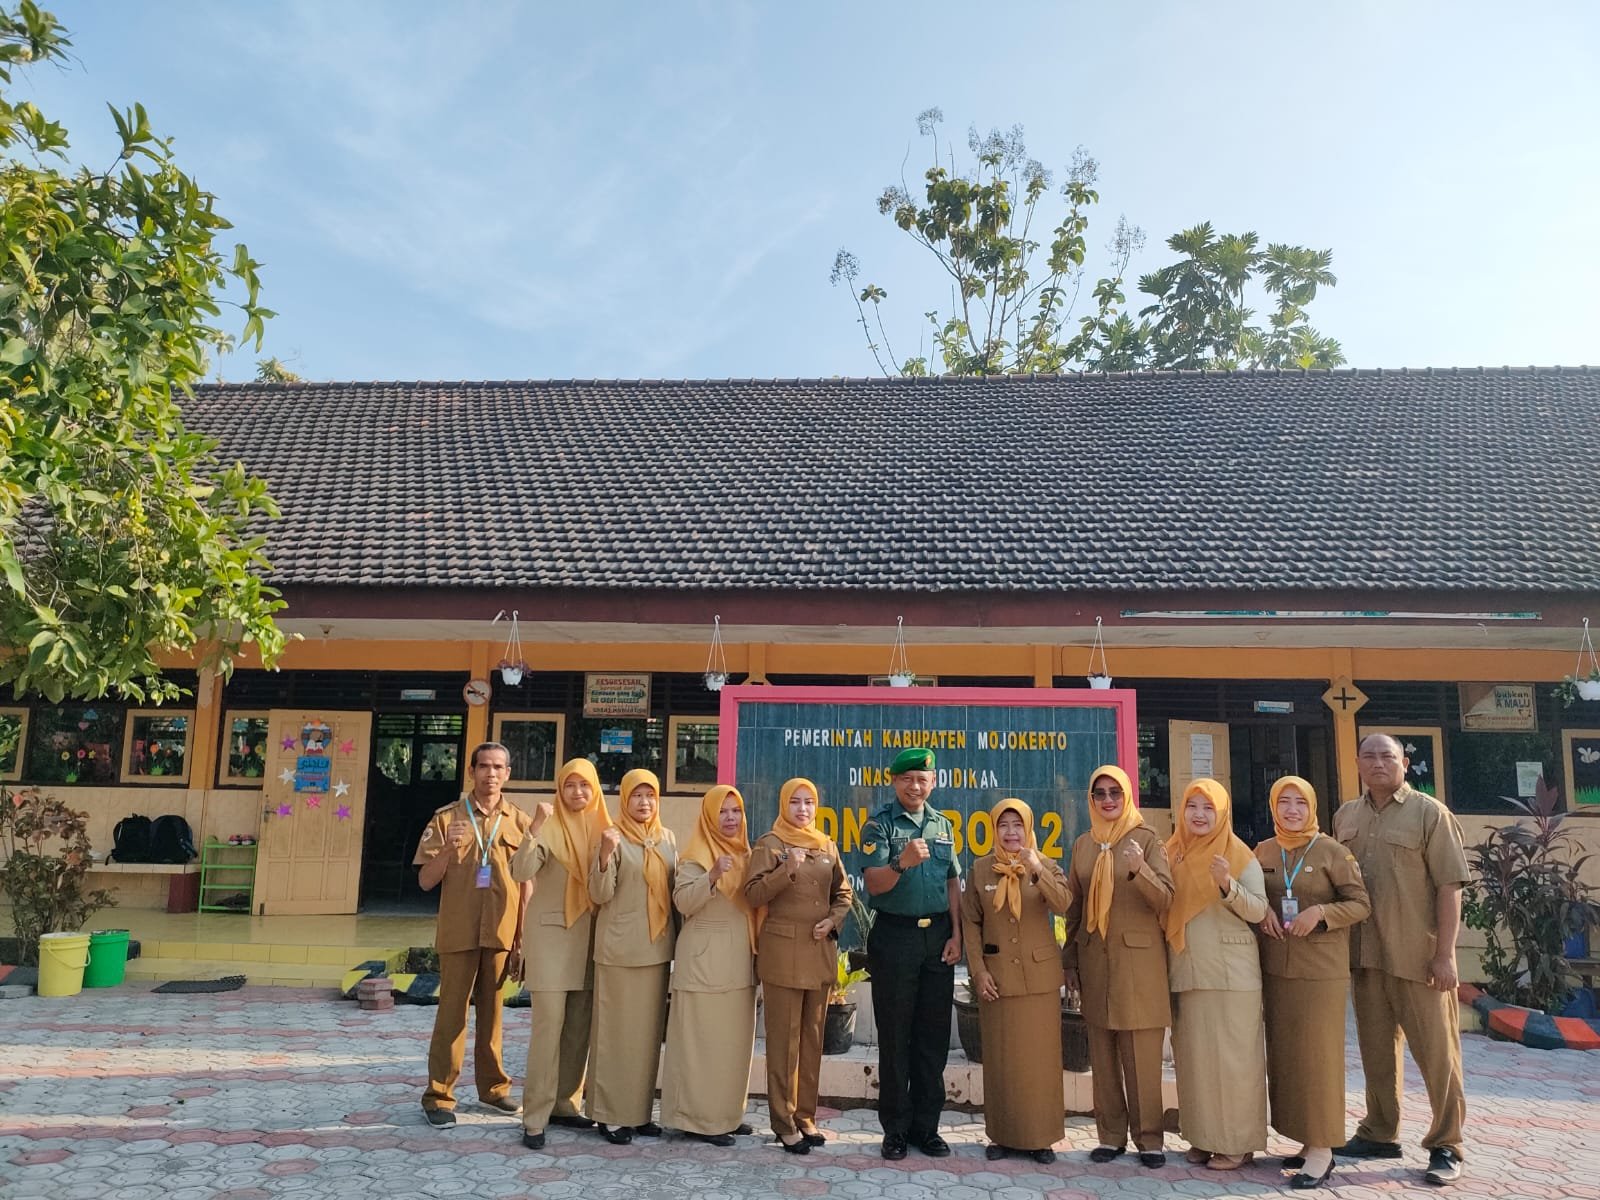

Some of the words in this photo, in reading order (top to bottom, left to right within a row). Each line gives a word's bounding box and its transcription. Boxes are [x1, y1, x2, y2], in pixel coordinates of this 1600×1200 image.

[1504, 698, 1530, 708] MALU
[784, 728, 873, 748] PEMERINTAH
[882, 729, 966, 749] KABUPATEN
[977, 731, 1067, 750] MOJOKERTO
[849, 766, 893, 787] DINAS
[816, 806, 868, 853] DN
[1040, 811, 1063, 859] 2
